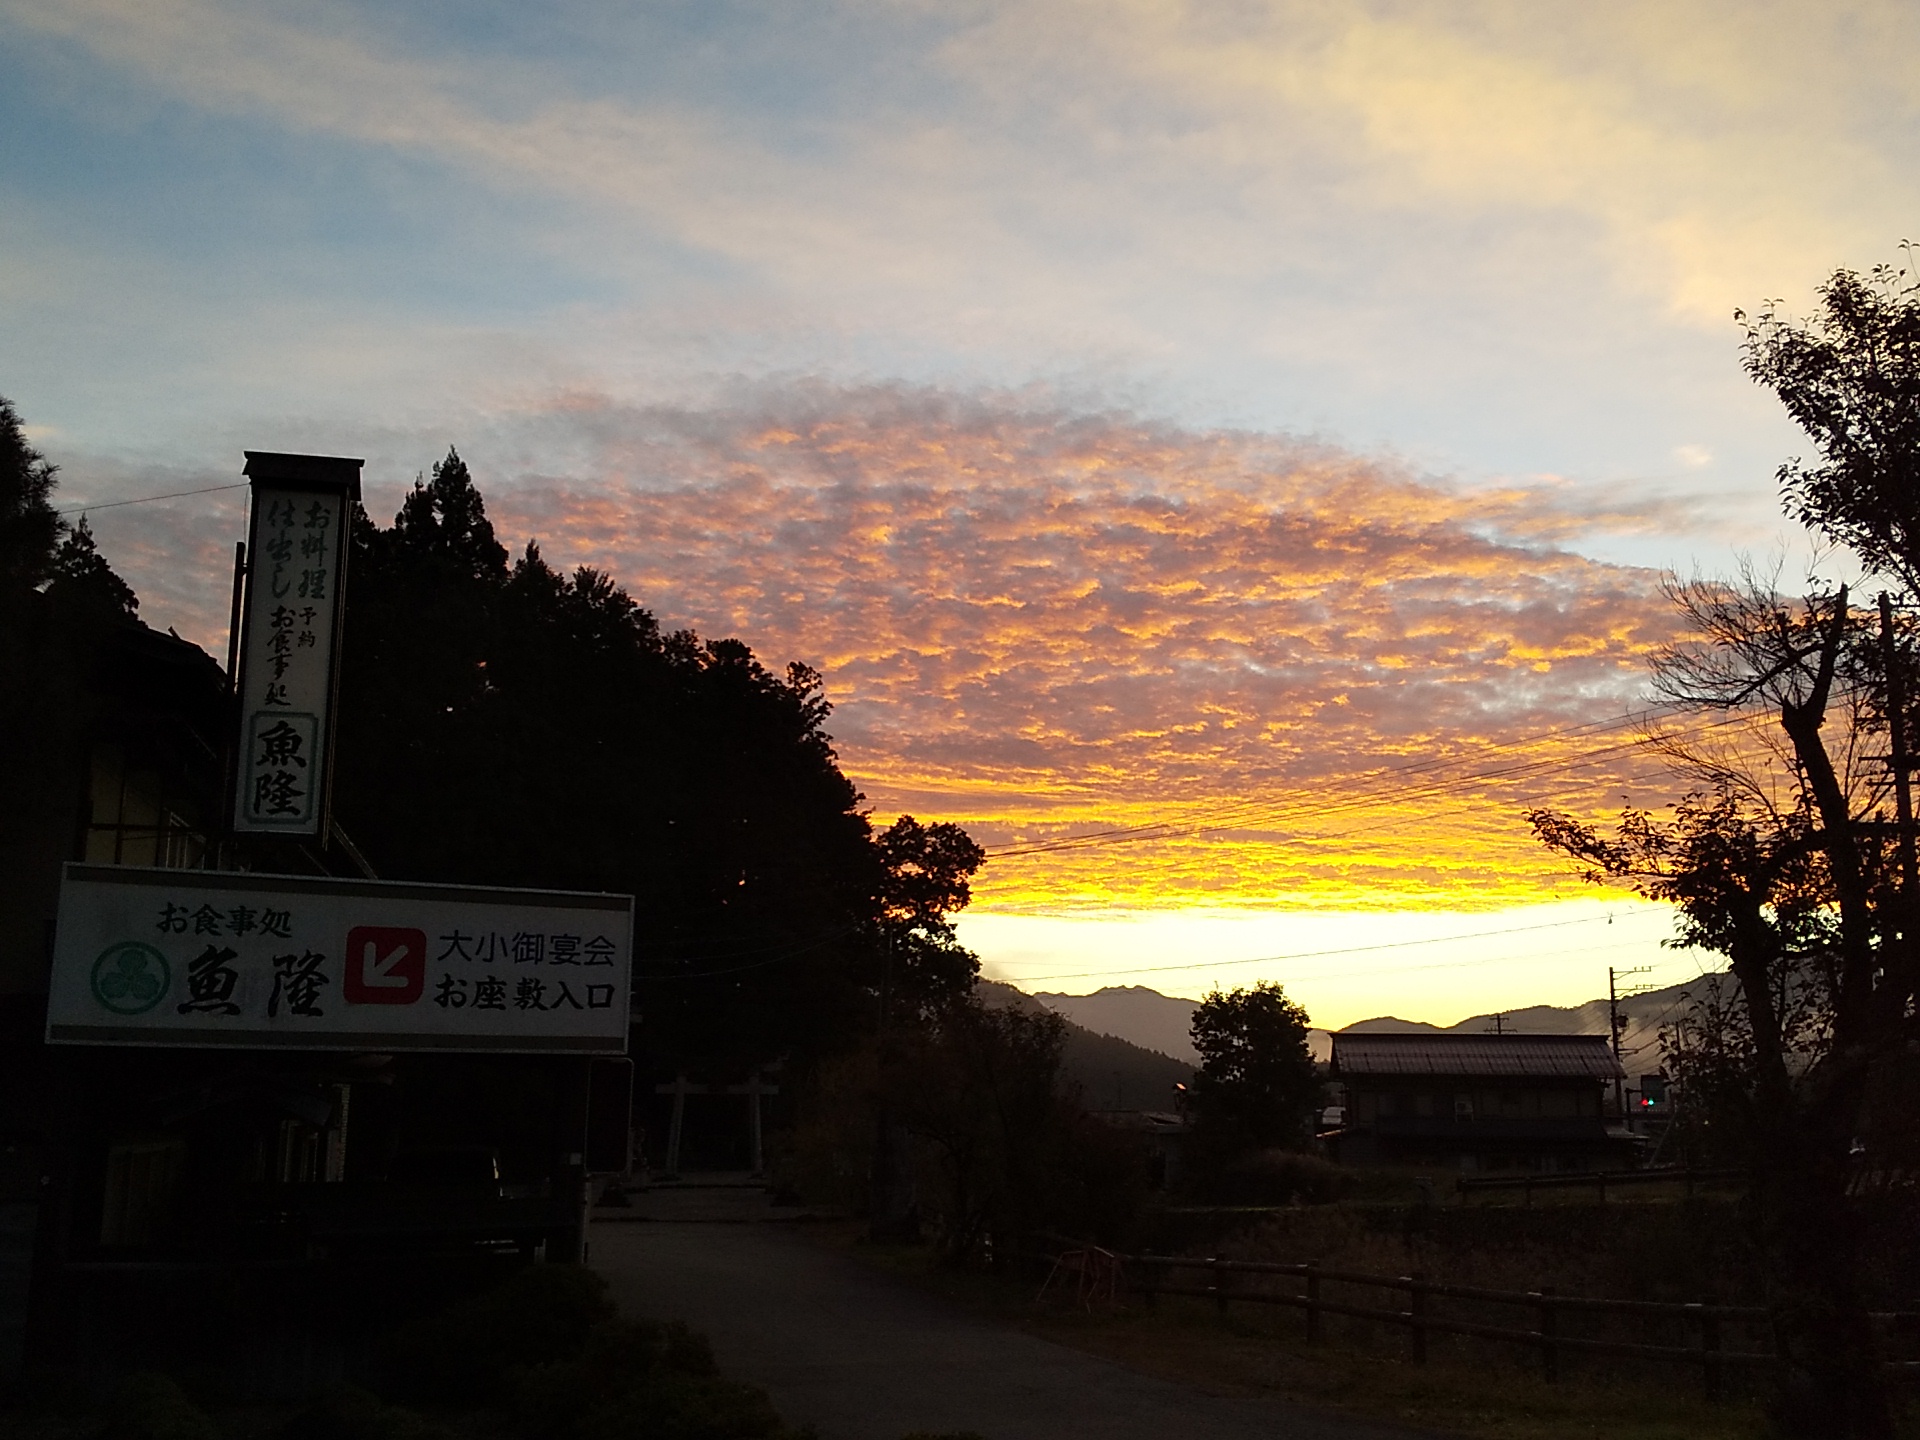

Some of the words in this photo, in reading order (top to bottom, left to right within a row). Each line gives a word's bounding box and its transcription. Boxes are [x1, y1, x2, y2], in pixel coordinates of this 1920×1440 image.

[266, 499, 295, 599] 仕出し
[299, 501, 331, 600] お料理
[265, 605, 296, 706] お食事処
[298, 606, 317, 648] 予約
[253, 720, 307, 816] 魚隆
[157, 902, 291, 939] お食事処
[437, 931, 616, 967] 大小御宴会
[177, 945, 330, 1018] 魚隆
[433, 975, 616, 1012] お座敷入口
